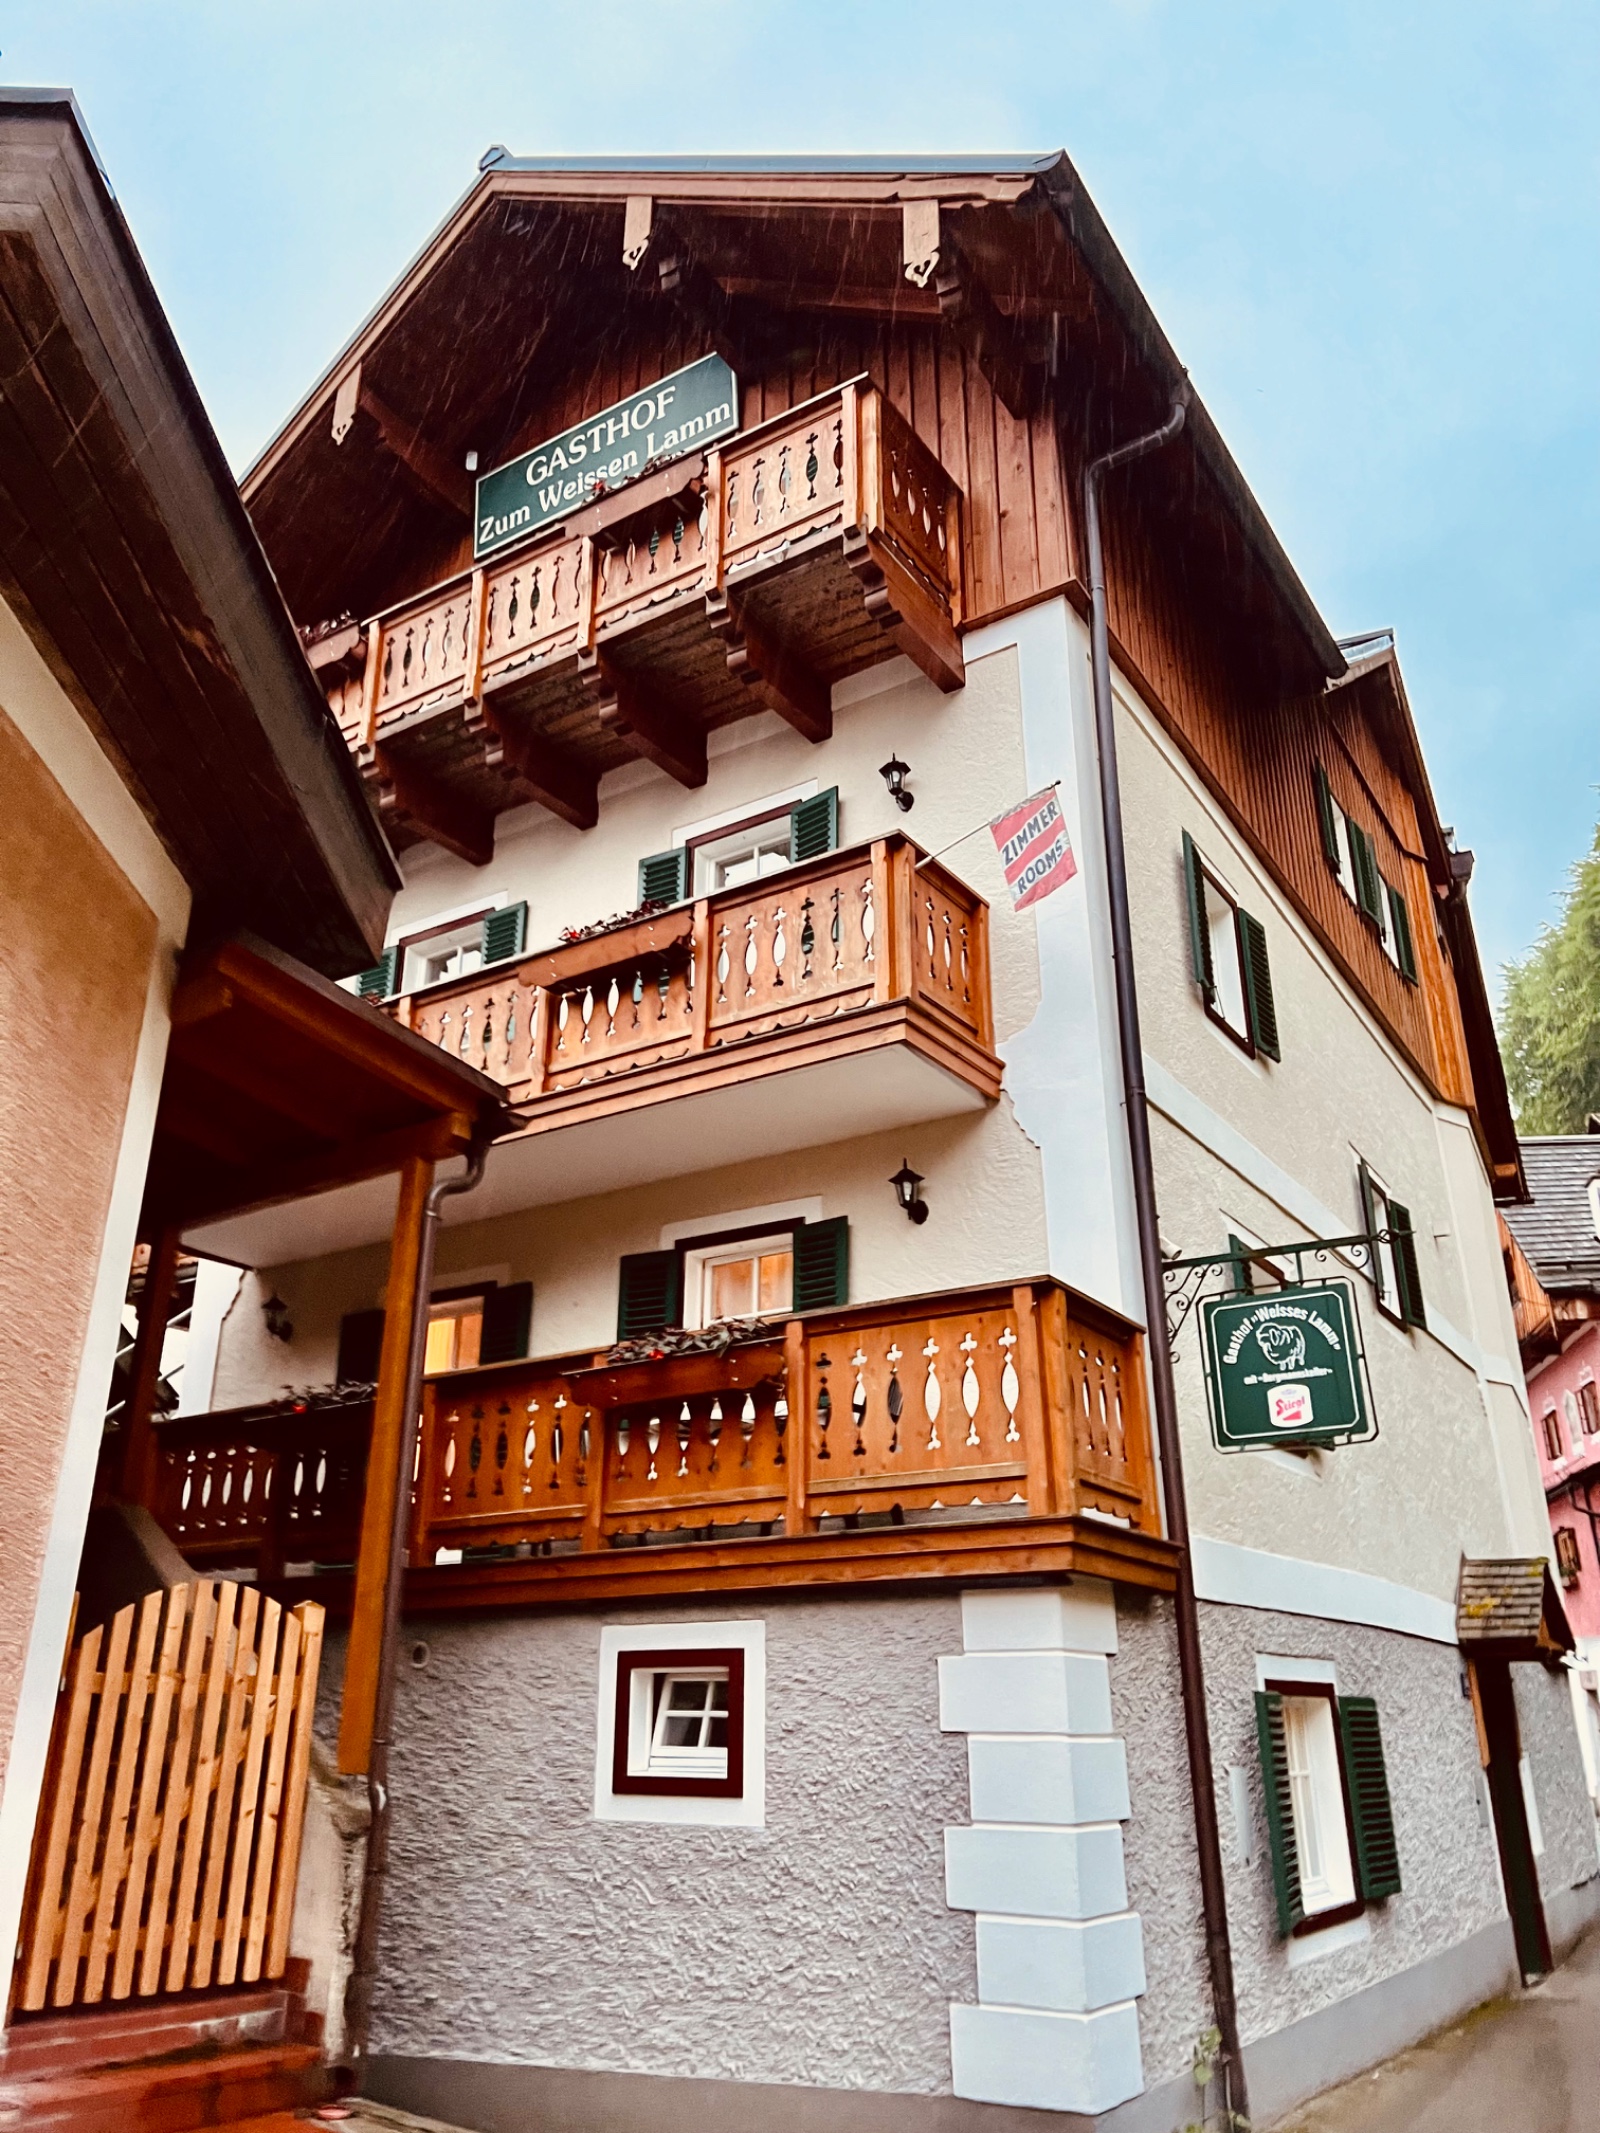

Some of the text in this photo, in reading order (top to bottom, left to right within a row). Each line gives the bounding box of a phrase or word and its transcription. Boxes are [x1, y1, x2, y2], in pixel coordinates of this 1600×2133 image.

[525, 385, 676, 486] GASTHOF
[478, 402, 731, 545] Zum Weissen Lamm
[1002, 801, 1058, 865] ZIMMER
[1017, 839, 1063, 894] ROOMS
[1222, 1317, 1253, 1364] Gasthof
[1275, 1395, 1306, 1417] Stiegl
